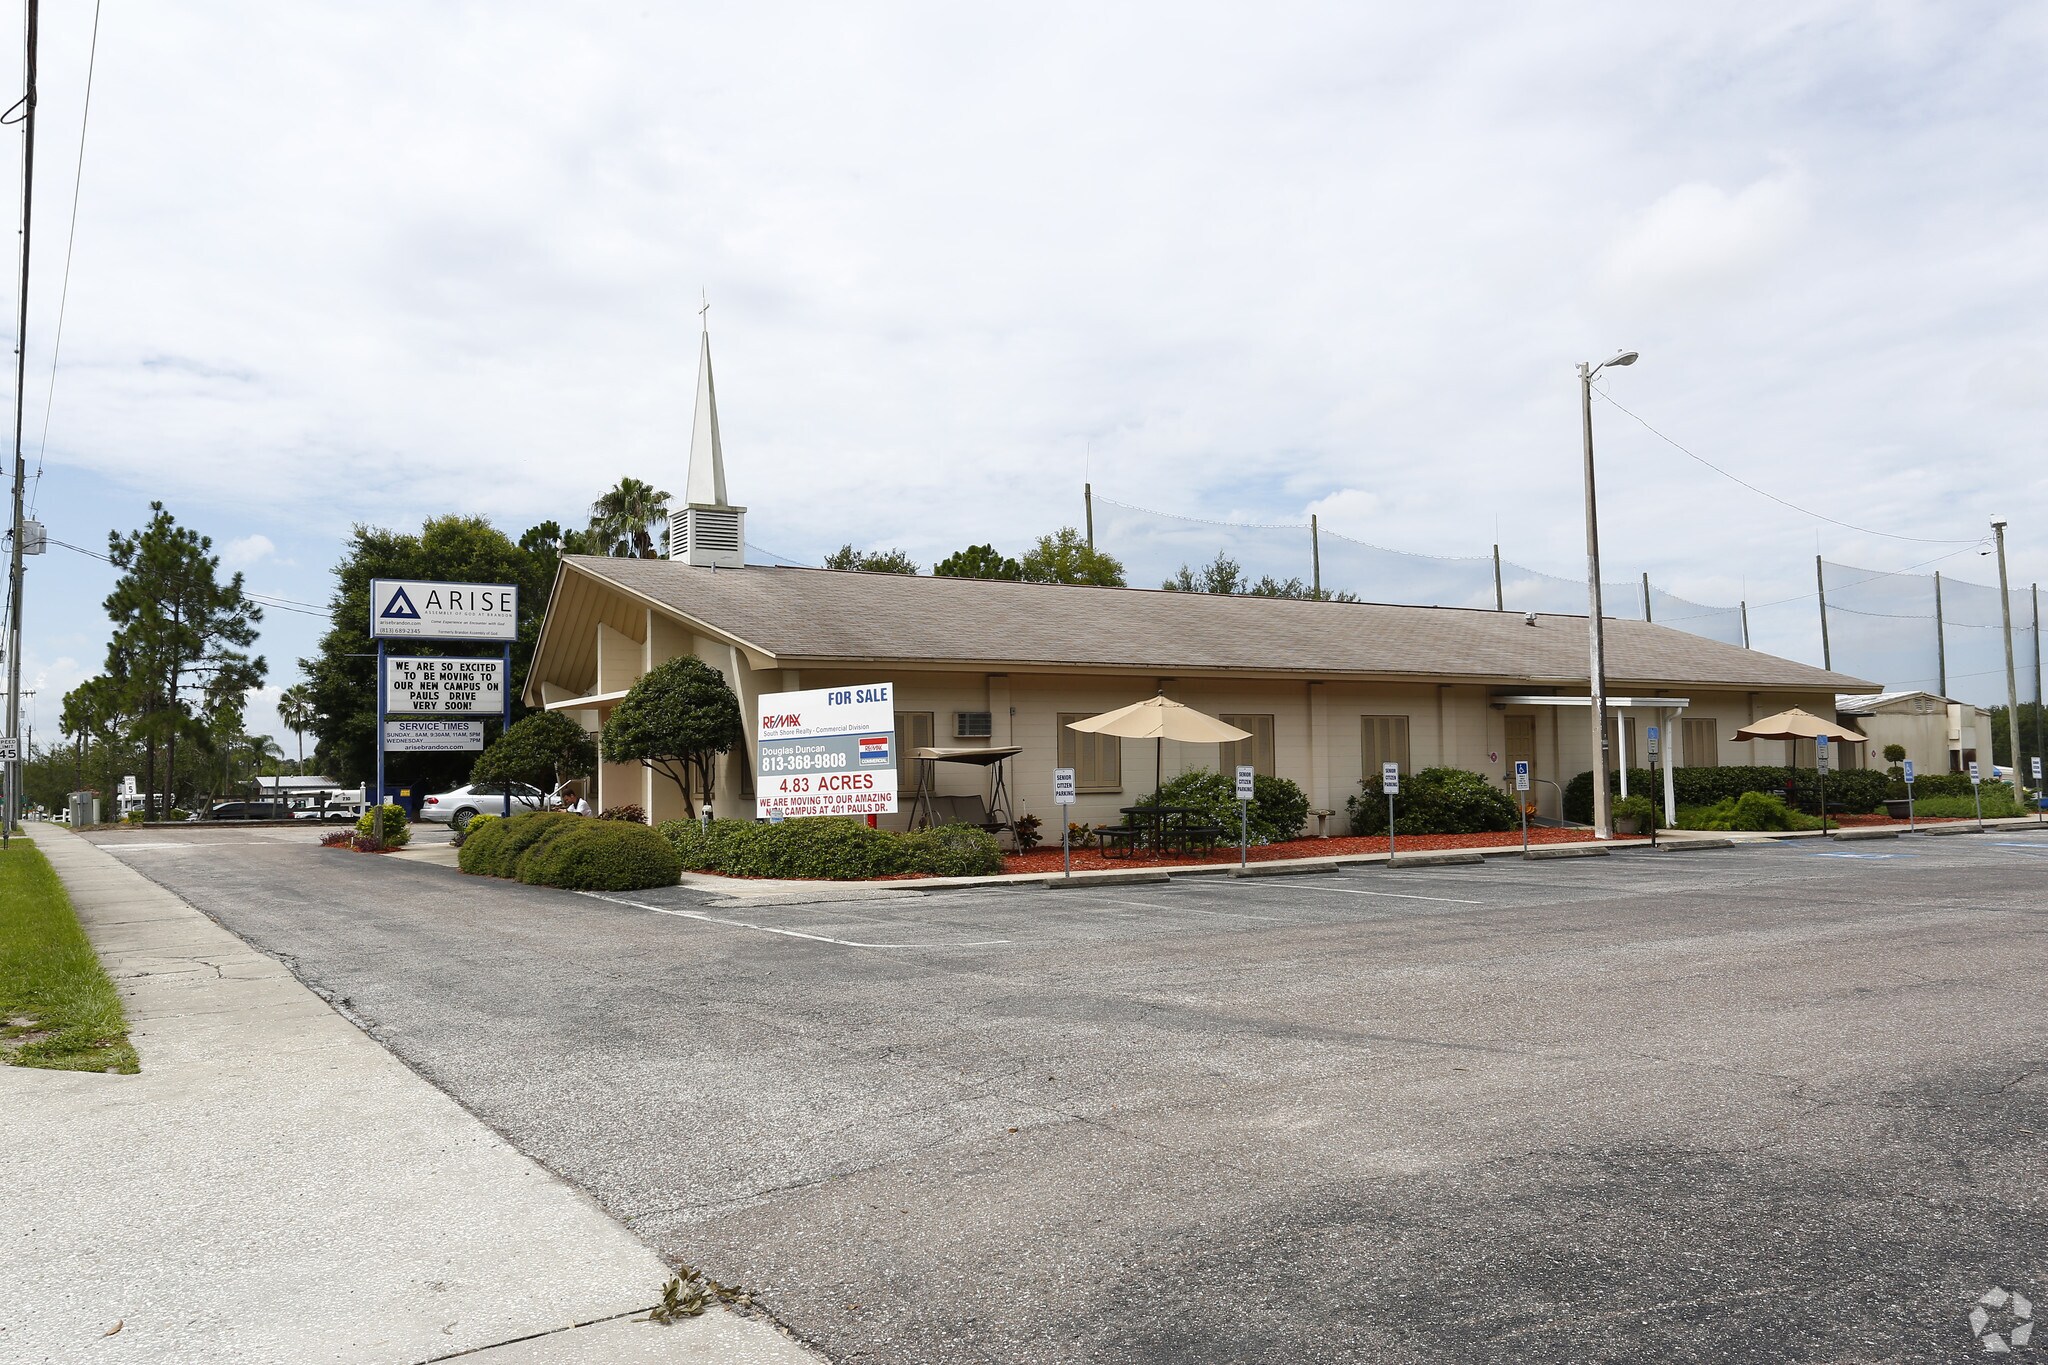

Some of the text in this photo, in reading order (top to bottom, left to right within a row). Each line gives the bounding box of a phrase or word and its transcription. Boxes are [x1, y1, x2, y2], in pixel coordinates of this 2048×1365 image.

[426, 590, 512, 612] ARISE
[396, 662, 496, 672] WE ARE SO EXCITED
[404, 672, 416, 680] TO
[440, 673, 474, 681] MOVING
[481, 673, 492, 681] TO
[394, 682, 413, 690] OUR
[444, 682, 480, 690] CAMPUS
[487, 683, 499, 691] ON
[410, 692, 476, 700] PAULS DRIVE
[828, 688, 887, 706] FOR SALE
[445, 702, 472, 710] SOON!
[763, 714, 801, 729] RE/MAX
[796, 728, 812, 736] Realty
[816, 724, 847, 733] Commercial
[0, 750, 16, 758] 45
[762, 746, 825, 756] Douglas Duncan
[762, 753, 846, 772] 813-368-9808
[780, 774, 873, 793] 4.83 ACRES
[760, 793, 892, 807] WE ARE MOVING TO OUR AMAZING
[785, 806, 817, 816] CAMPUS
[819, 806, 828, 814] AT
[831, 805, 844, 813] 401
[847, 804, 872, 812] PAULS
[875, 803, 888, 811] DR.
